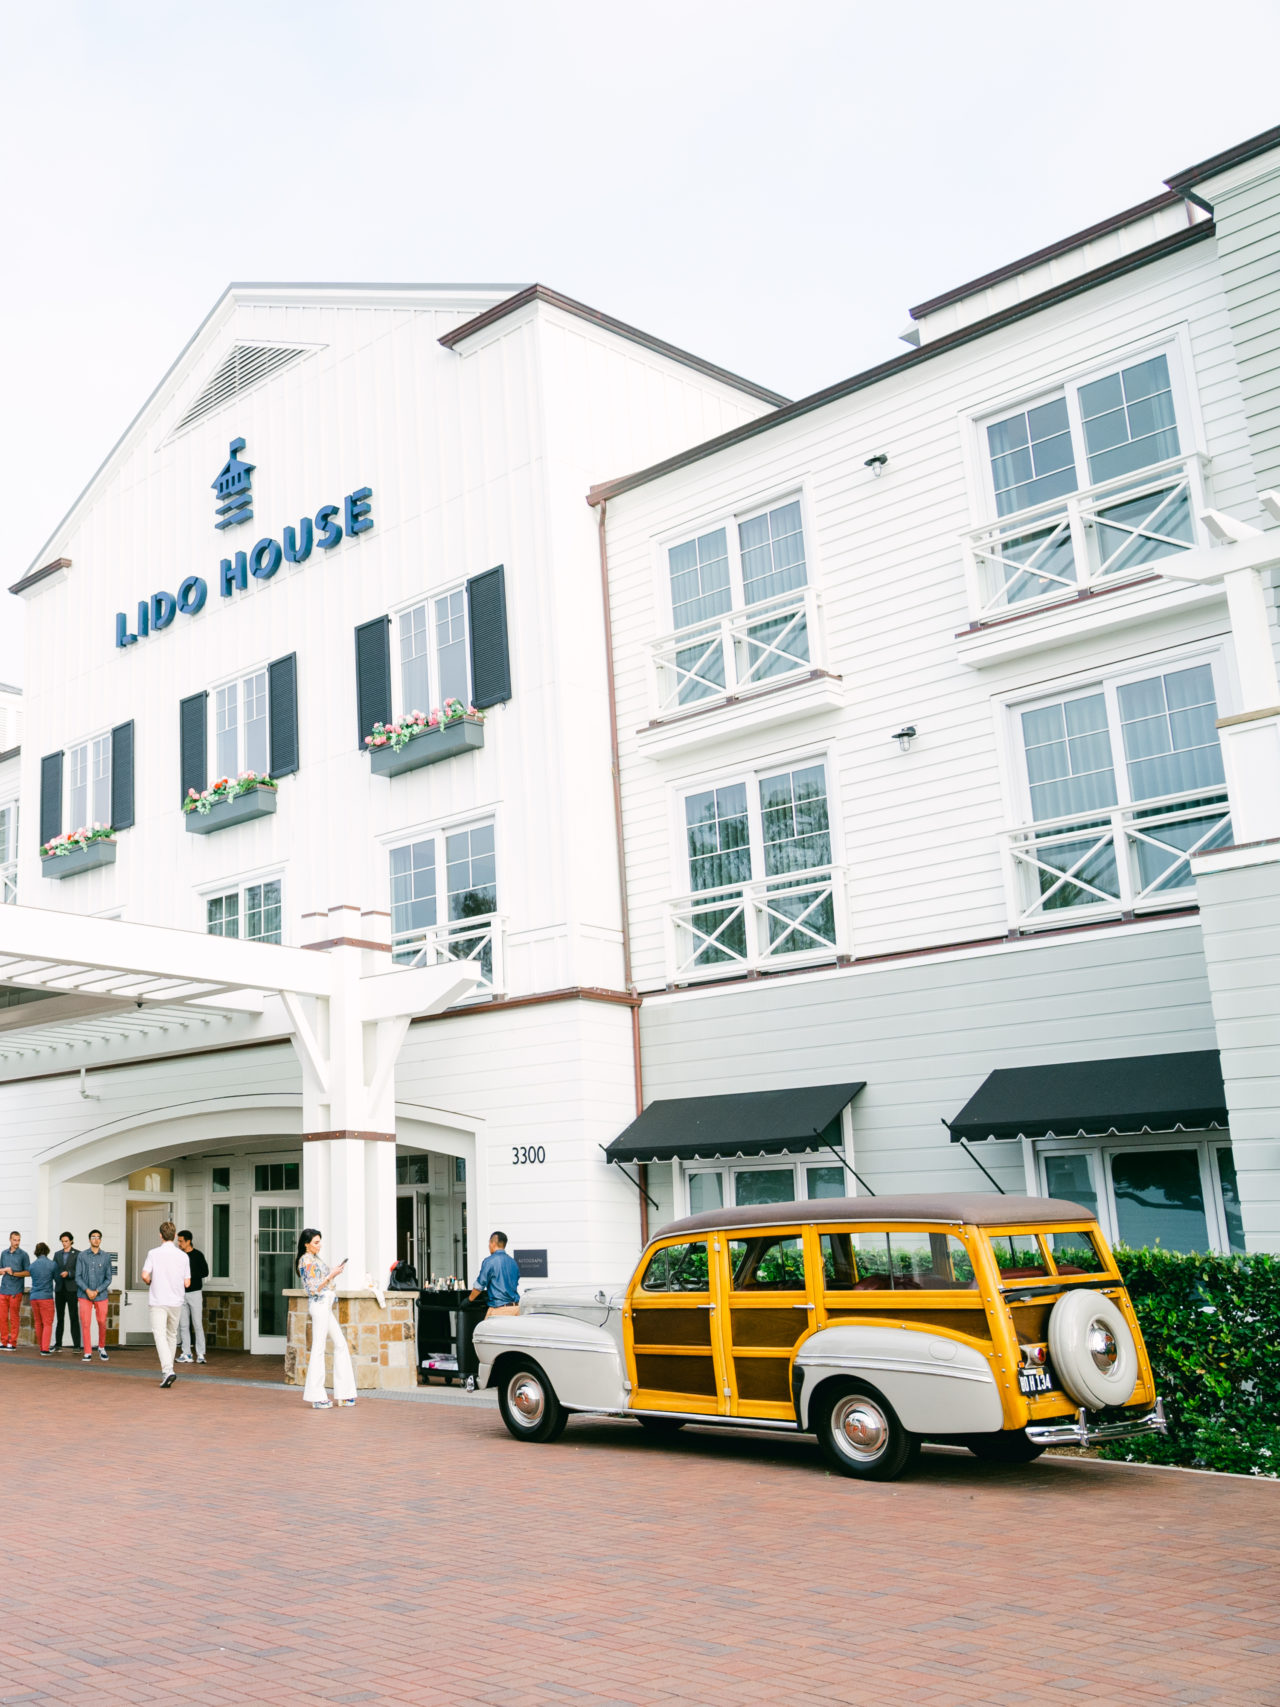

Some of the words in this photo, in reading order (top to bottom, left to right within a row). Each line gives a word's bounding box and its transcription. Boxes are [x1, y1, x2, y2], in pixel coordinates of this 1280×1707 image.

[116, 576, 207, 648] LIDO
[220, 487, 373, 598] HOUSE
[512, 1146, 546, 1164] 3300
